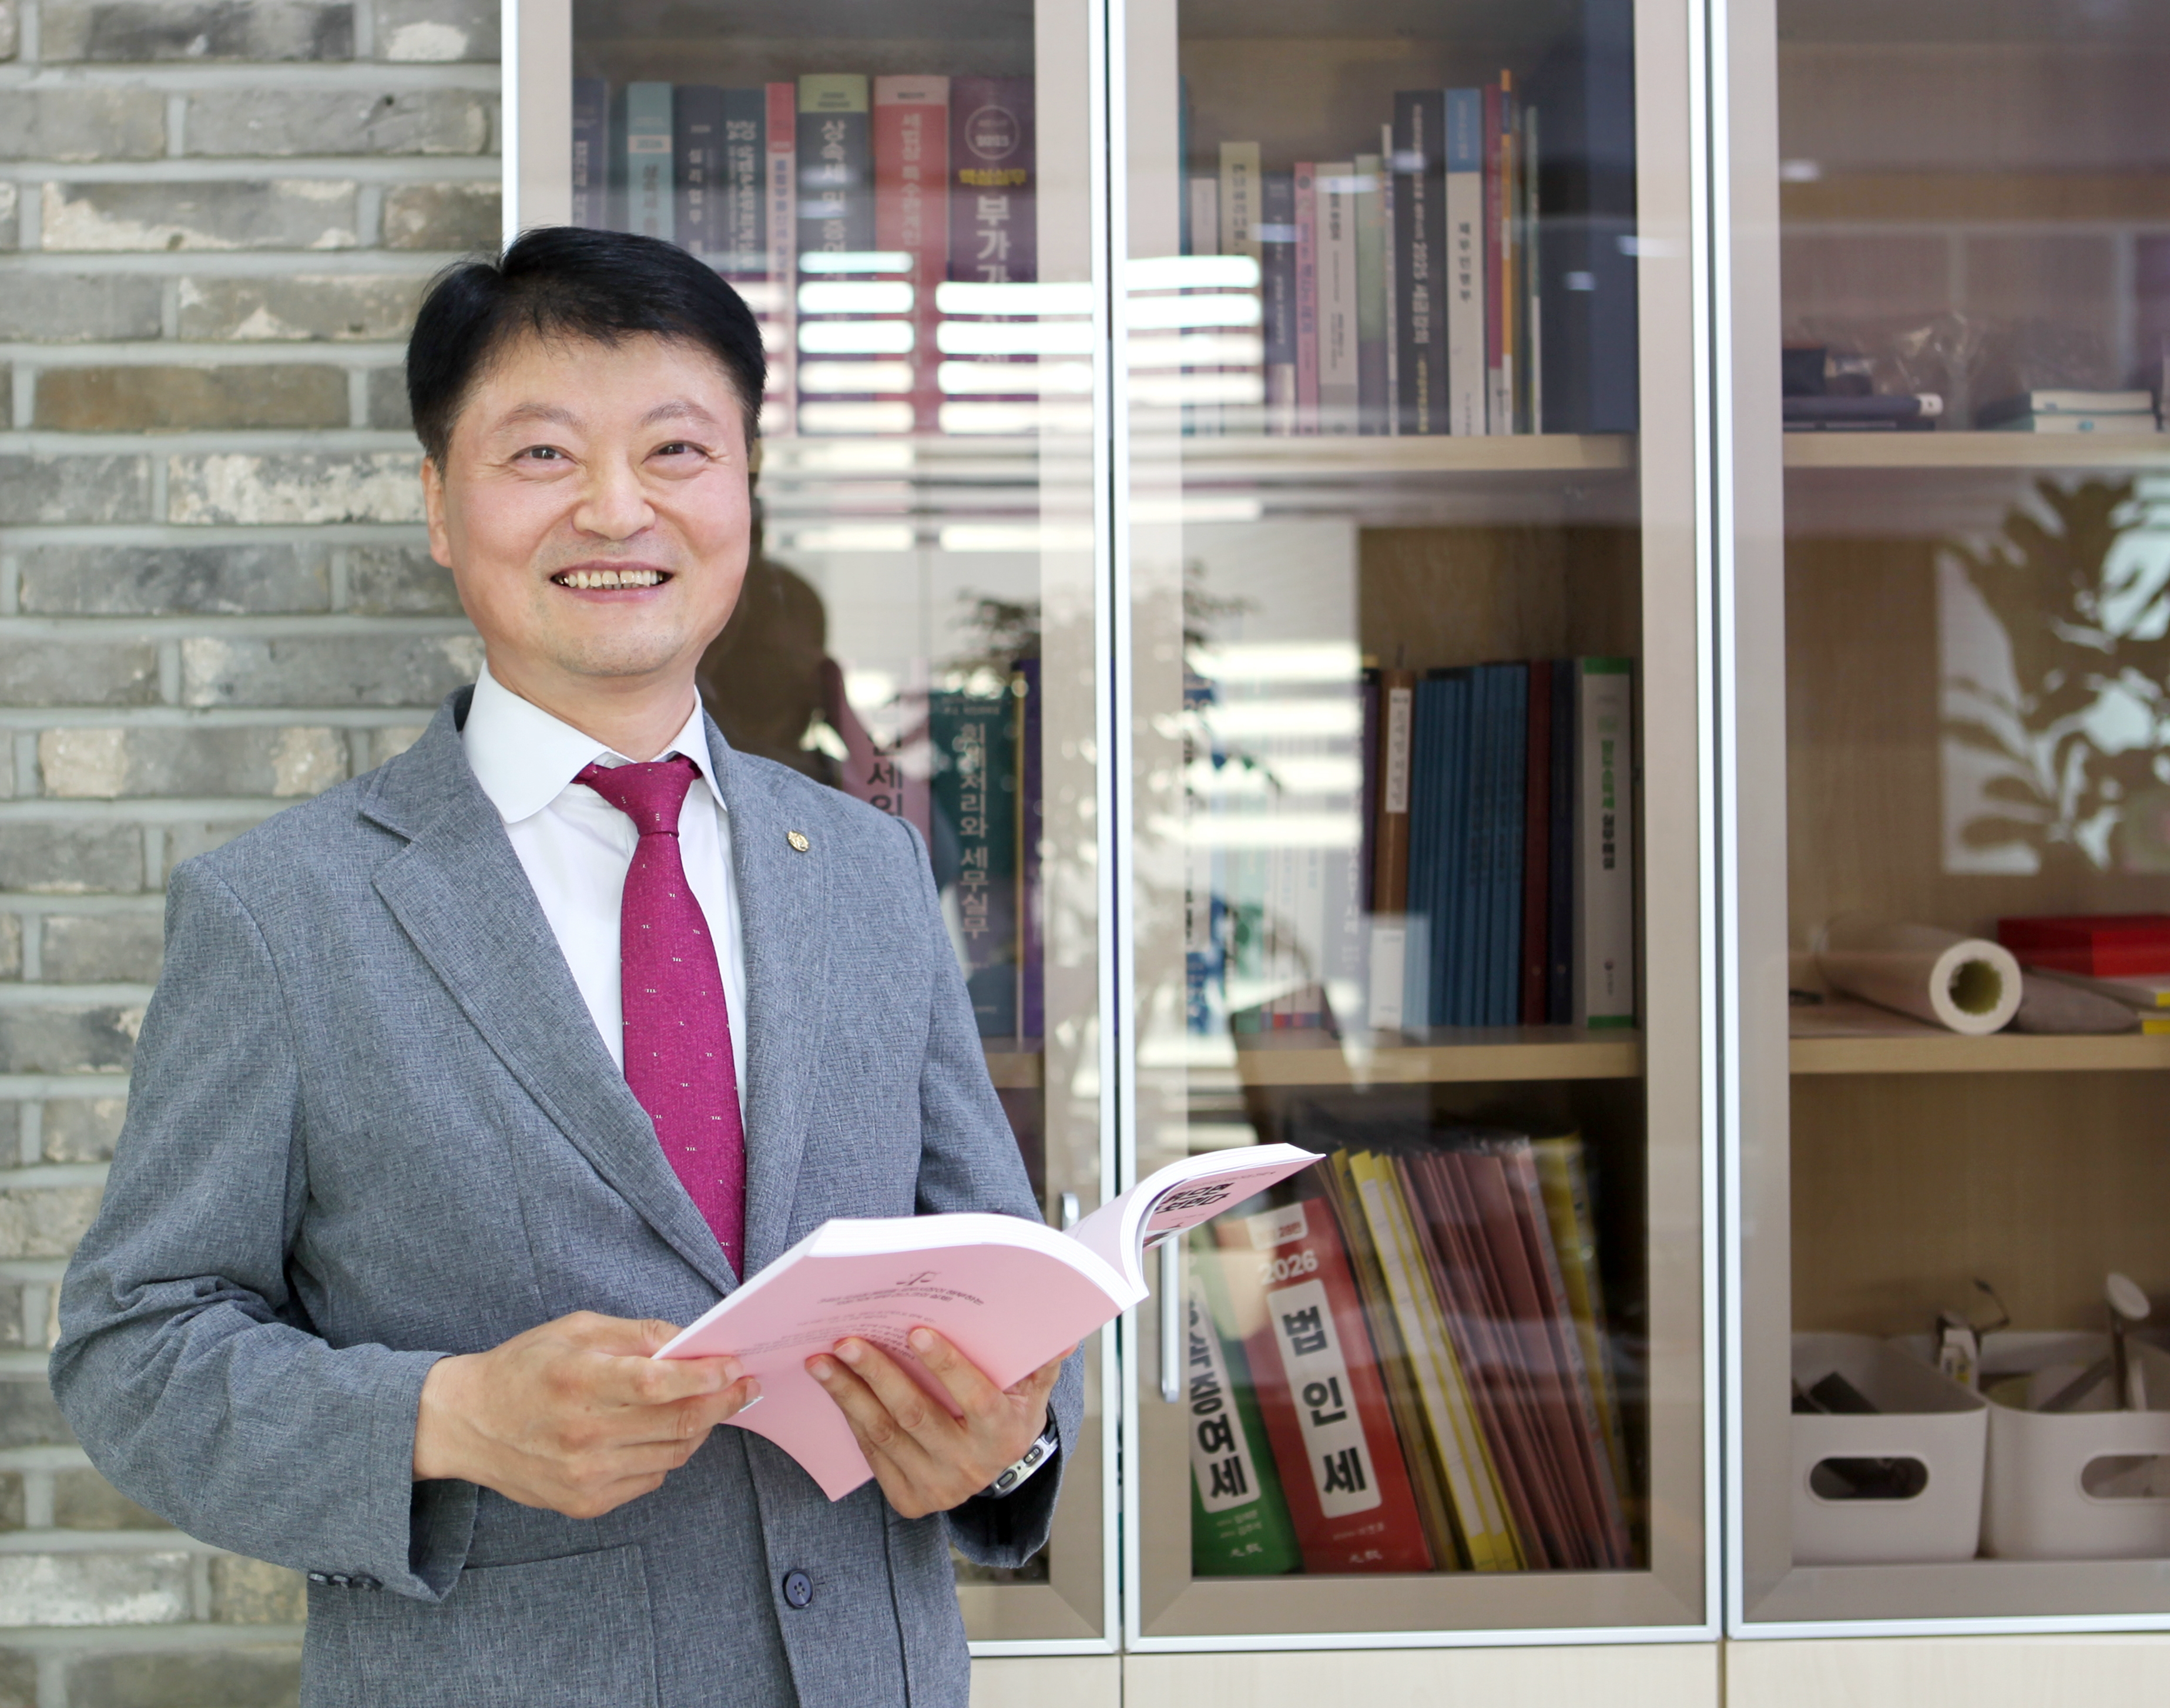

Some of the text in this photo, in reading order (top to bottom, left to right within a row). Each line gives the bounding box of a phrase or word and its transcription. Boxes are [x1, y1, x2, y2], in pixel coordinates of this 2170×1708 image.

[821, 119, 846, 183] 상속세
[960, 845, 989, 939] 세무실무
[1258, 1250, 1319, 1286] 2026
[1282, 1304, 1367, 1496] 법인세
